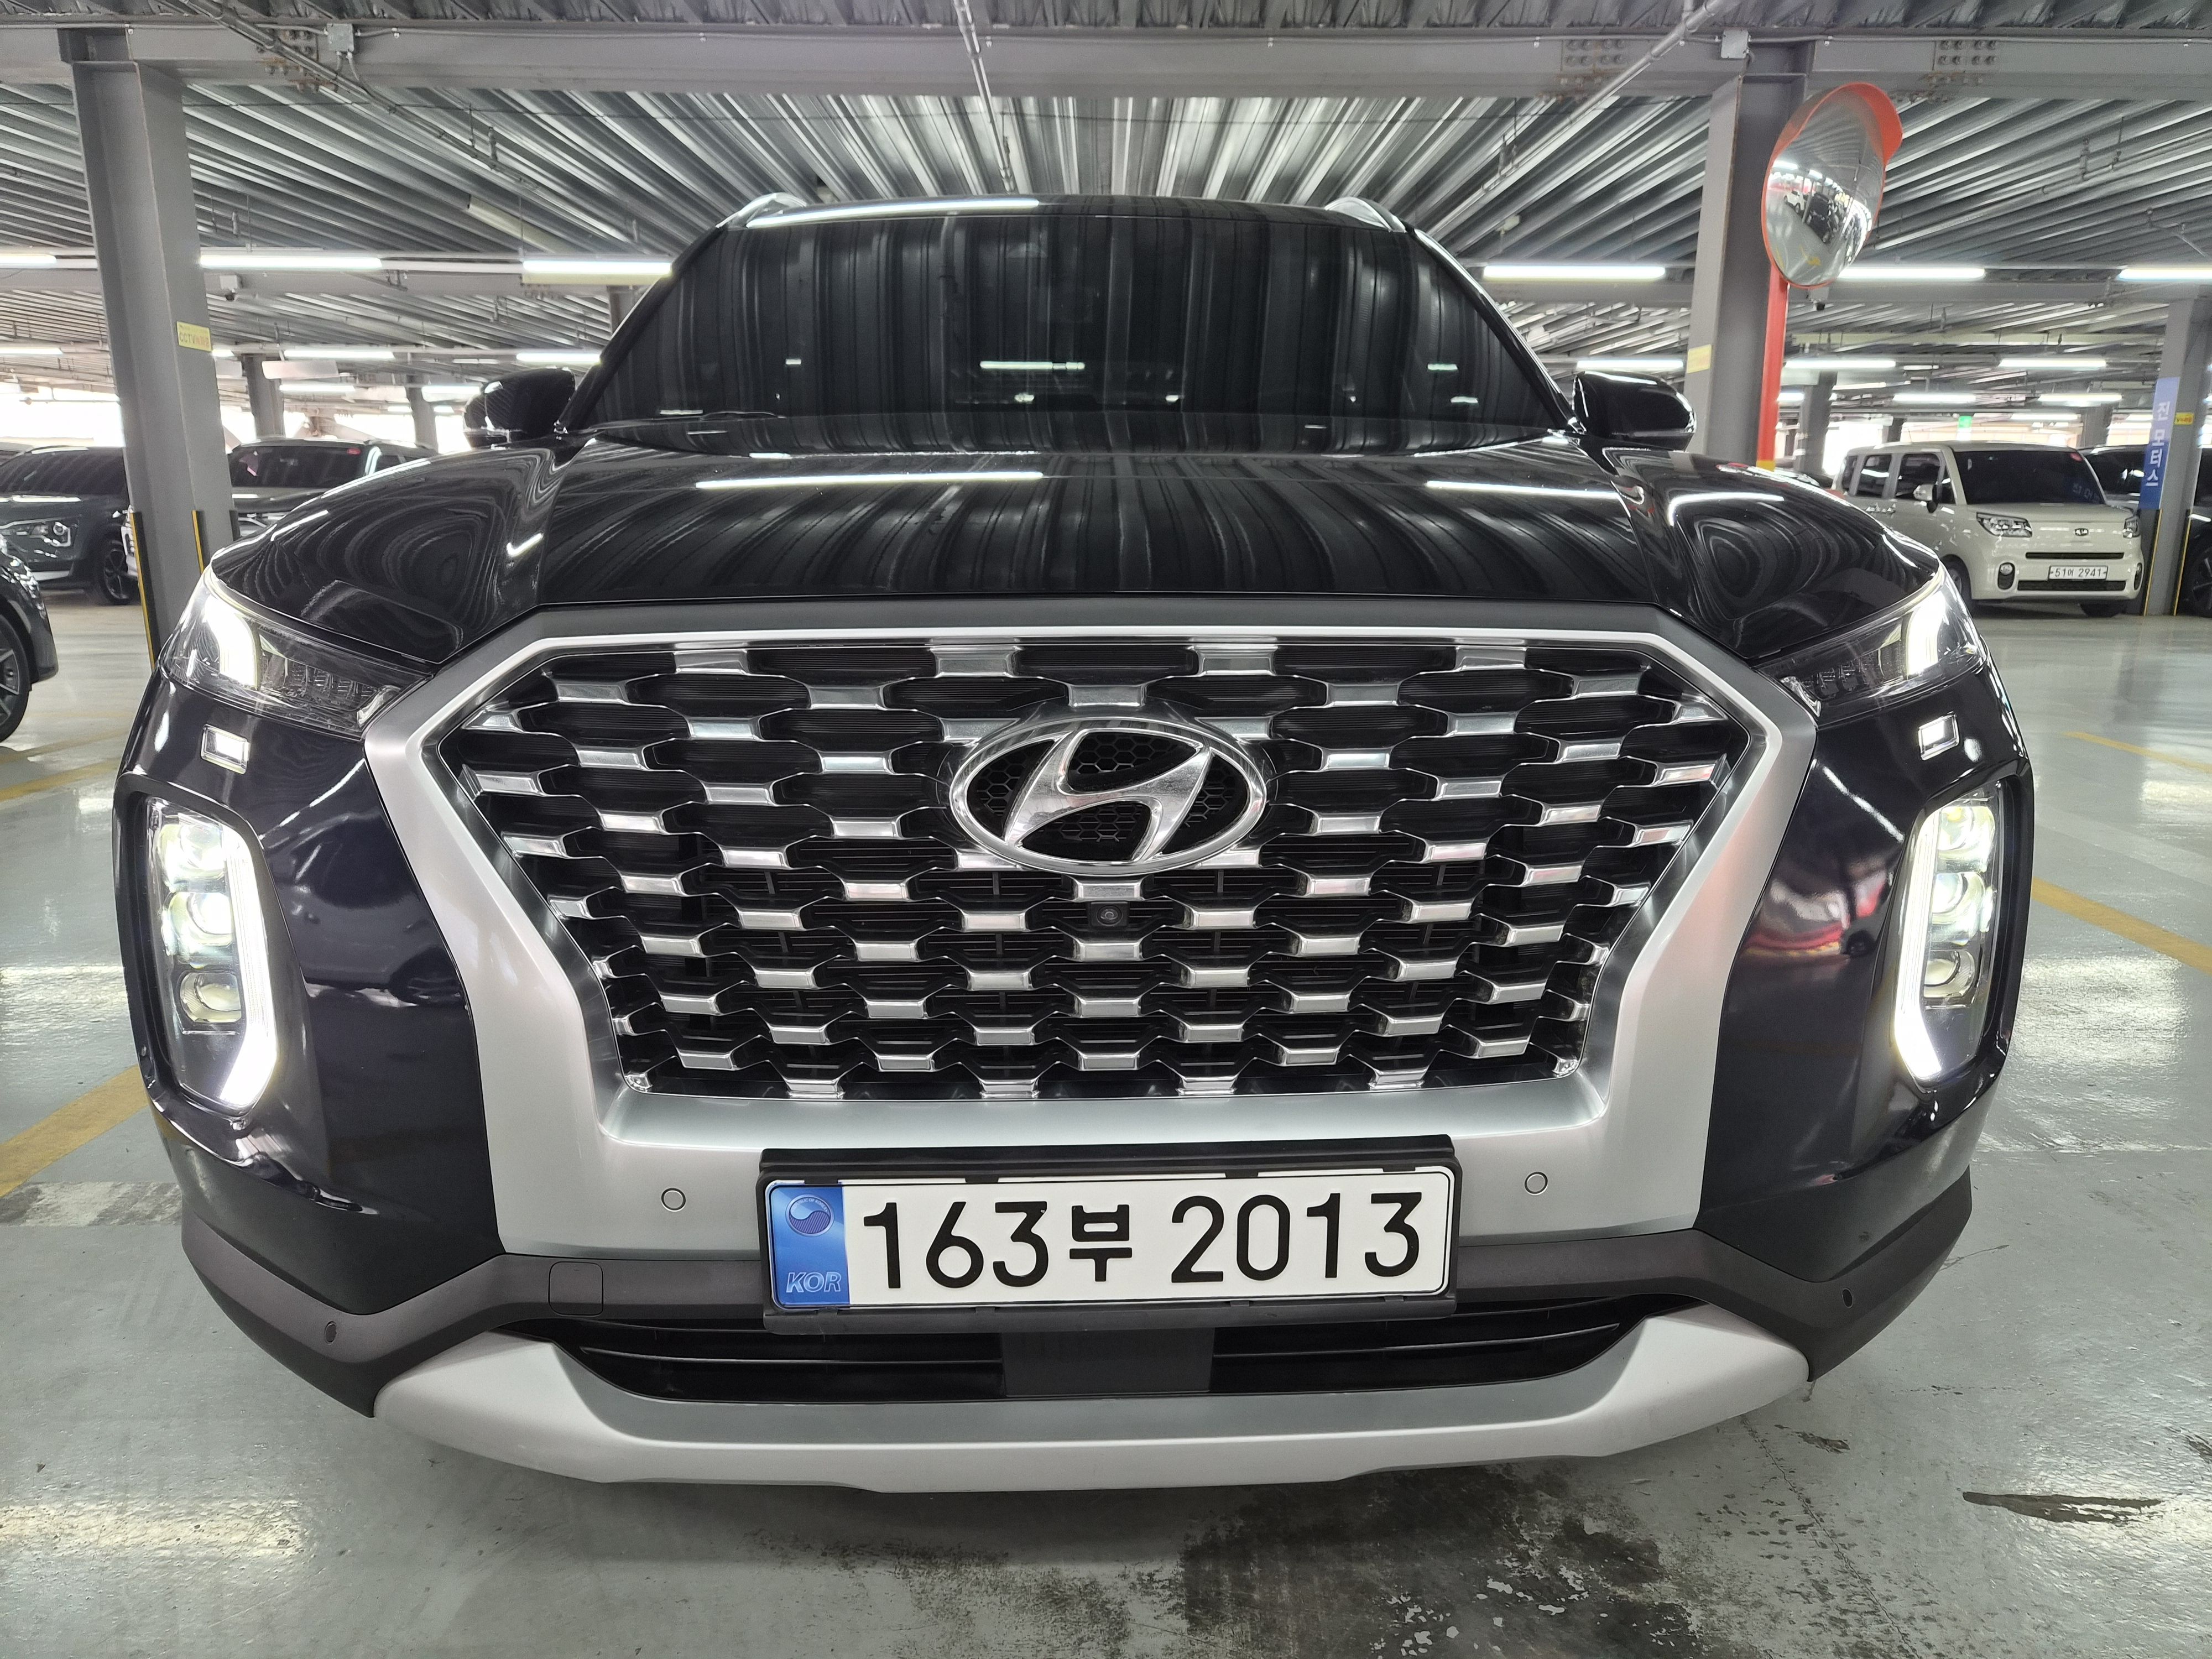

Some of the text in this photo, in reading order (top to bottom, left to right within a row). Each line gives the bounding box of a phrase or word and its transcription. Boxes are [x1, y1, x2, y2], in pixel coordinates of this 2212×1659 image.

[2145, 429, 2166, 487] 모터스
[2079, 568, 2101, 577] 2941
[863, 1192, 1423, 1289] 163부 2013
[786, 1271, 842, 1293] KOR
